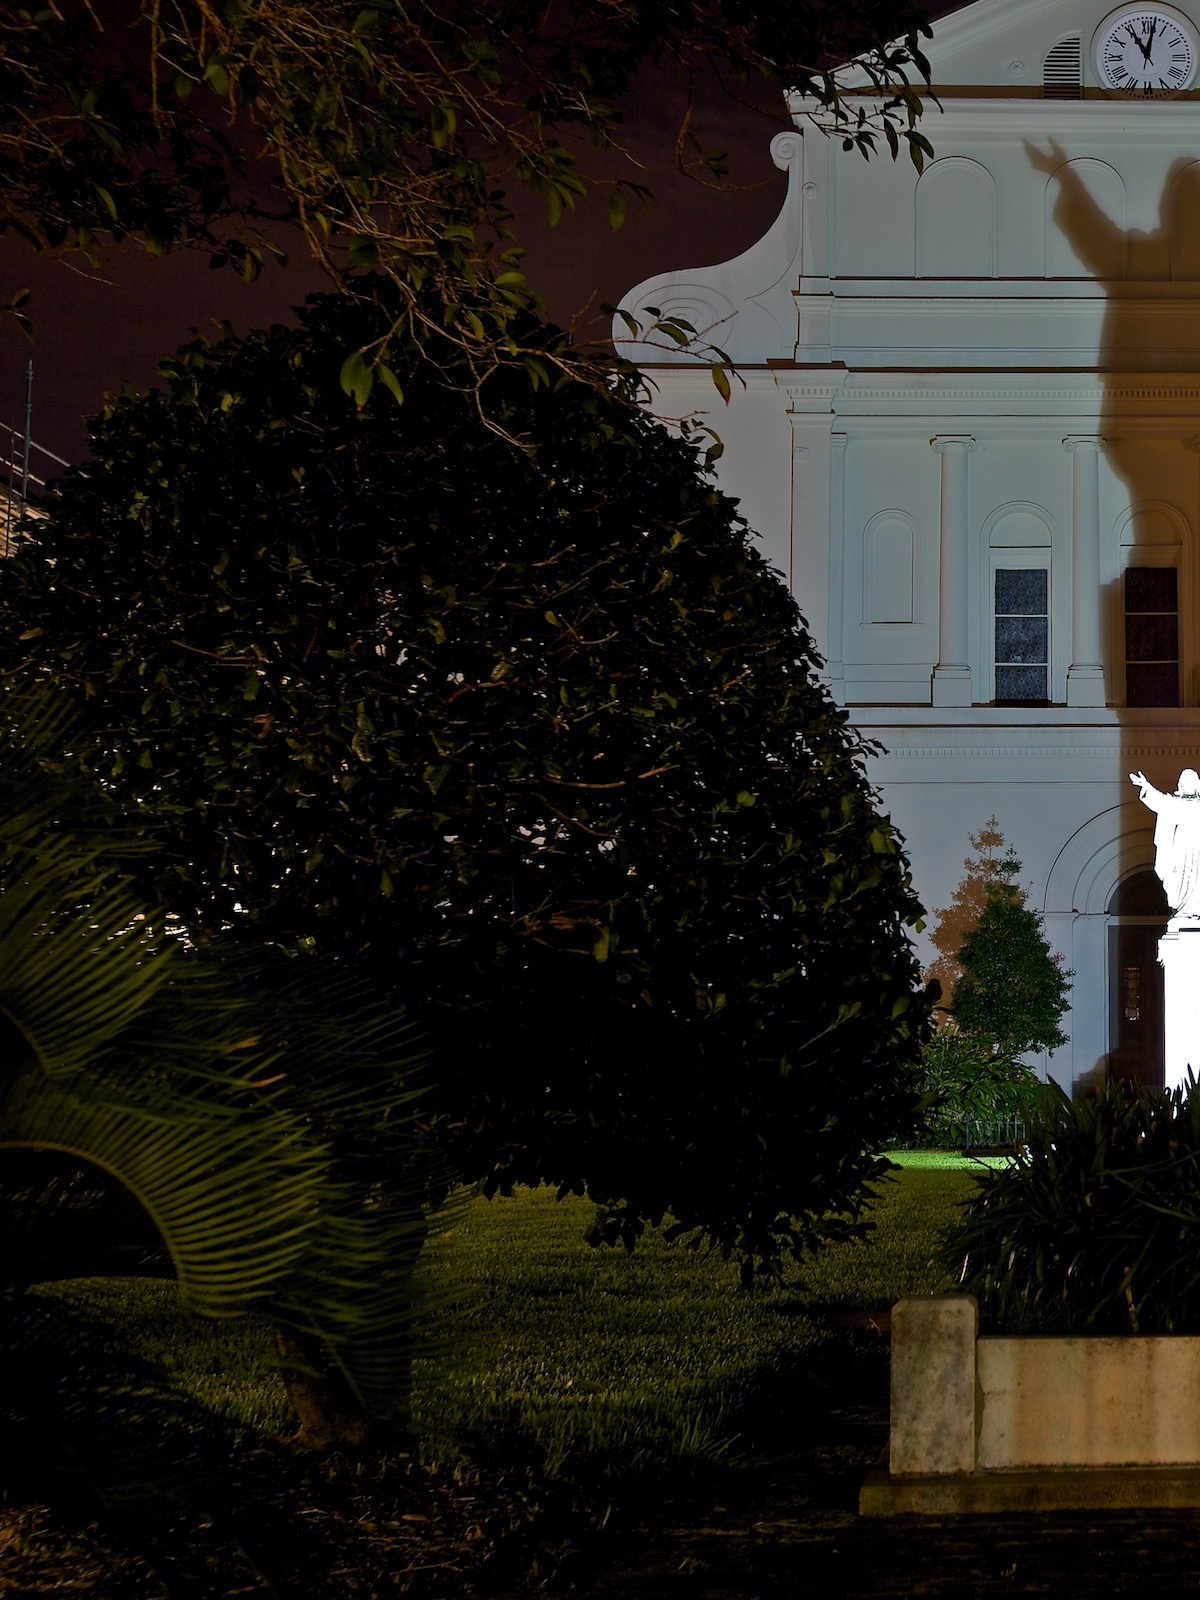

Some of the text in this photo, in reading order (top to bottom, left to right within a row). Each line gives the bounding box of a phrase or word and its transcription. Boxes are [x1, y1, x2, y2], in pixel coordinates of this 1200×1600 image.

[1158, 25, 1167, 37] I
[1112, 36, 1126, 48] X
[1168, 37, 1181, 48] II
[1108, 53, 1123, 62] IX
[1172, 54, 1186, 62] III
[1111, 65, 1129, 81] VIII
[1124, 76, 1138, 92] VII
[1143, 81, 1153, 95] VI
[1158, 77, 1170, 92] V
